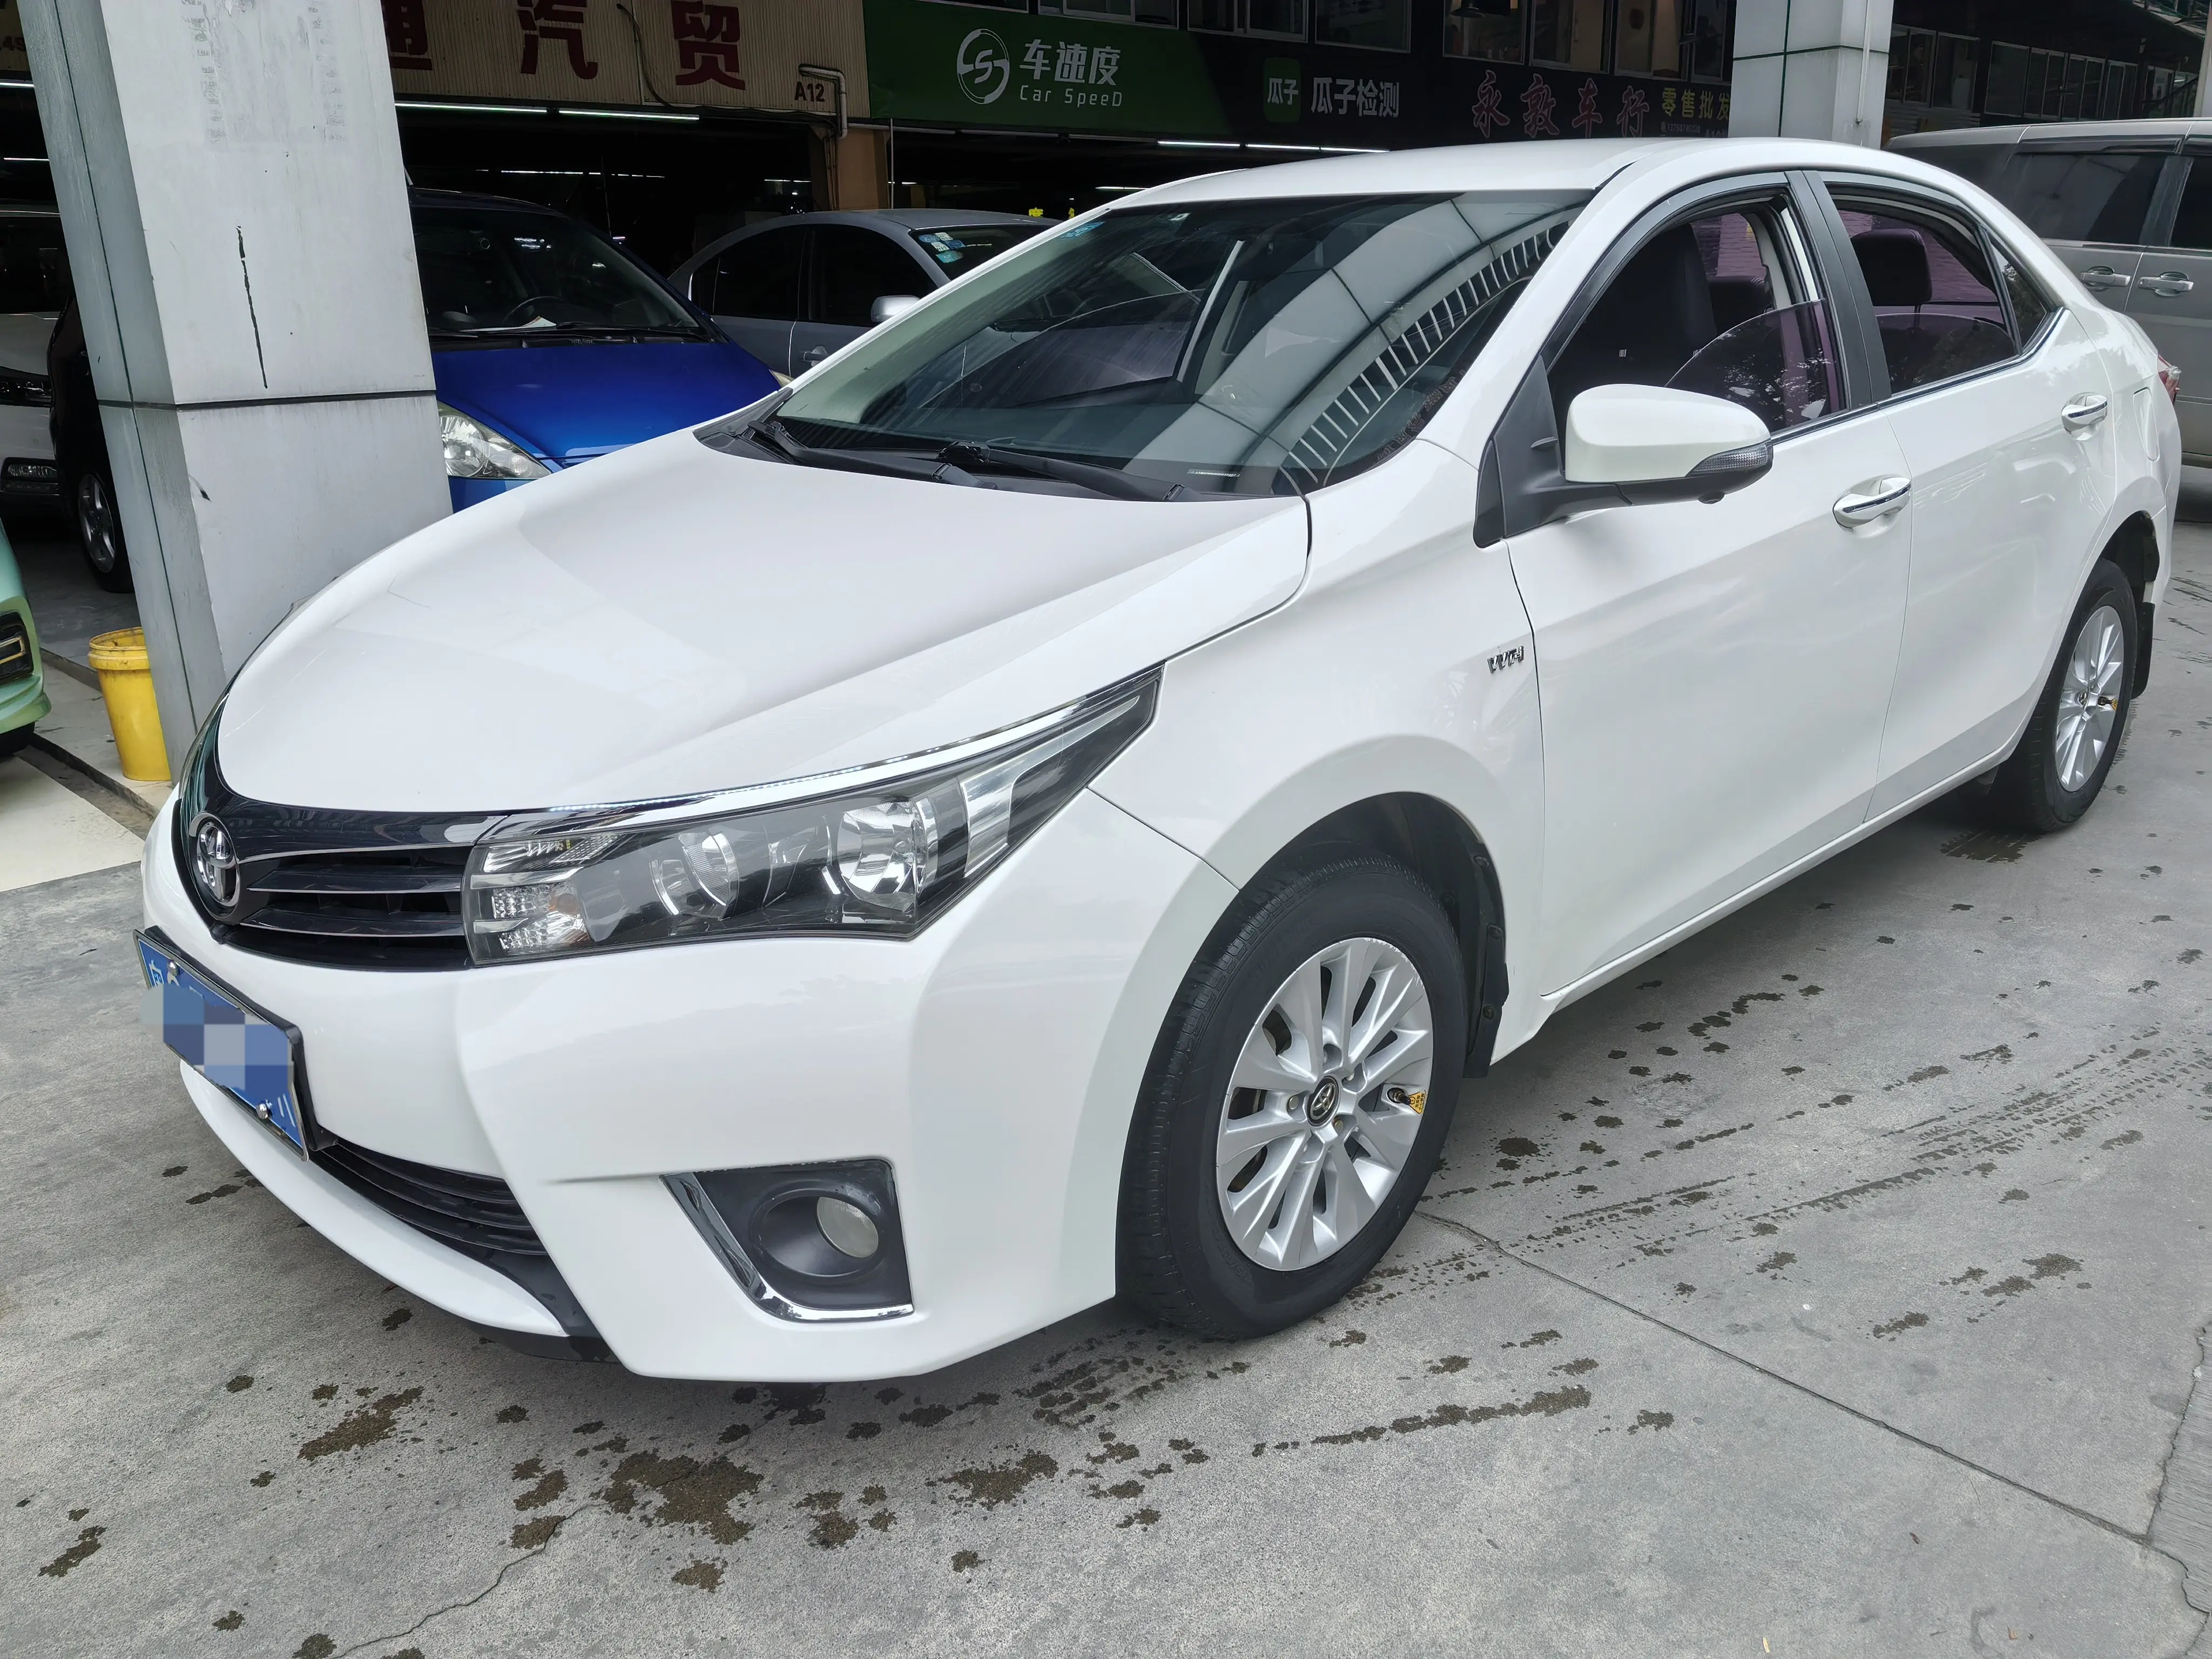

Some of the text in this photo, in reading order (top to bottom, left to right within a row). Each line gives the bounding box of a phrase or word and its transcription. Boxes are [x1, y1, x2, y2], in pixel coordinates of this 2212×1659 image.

[1020, 39, 1121, 85] 车速度
[794, 82, 825, 102] A12
[1020, 85, 1052, 102] Car
[1267, 78, 1299, 105] 瓜子
[1311, 77, 1400, 118] 瓜子检测
[1662, 87, 1730, 120] 零售批发
